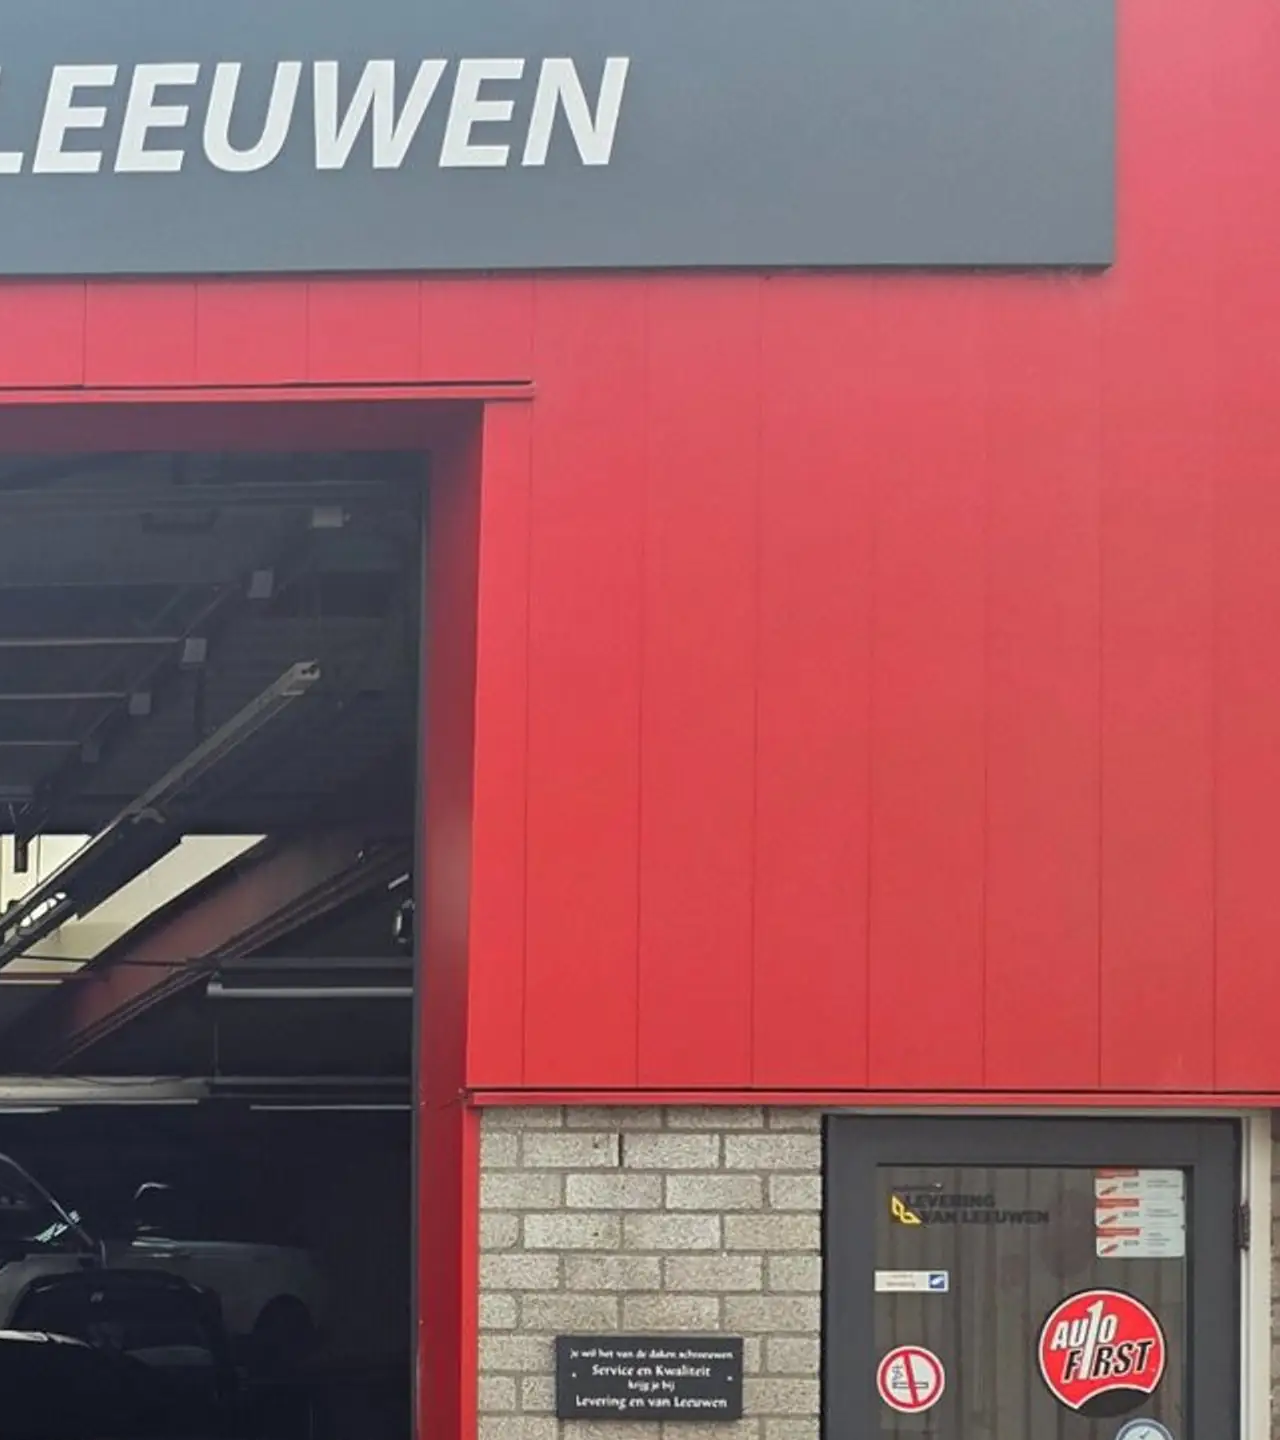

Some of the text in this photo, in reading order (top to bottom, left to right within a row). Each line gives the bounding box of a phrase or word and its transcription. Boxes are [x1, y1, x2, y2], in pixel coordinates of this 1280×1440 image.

[591, 1364, 712, 1377] Service en Kwaliteit
[575, 1395, 728, 1411] Levering en van Leeuwen
